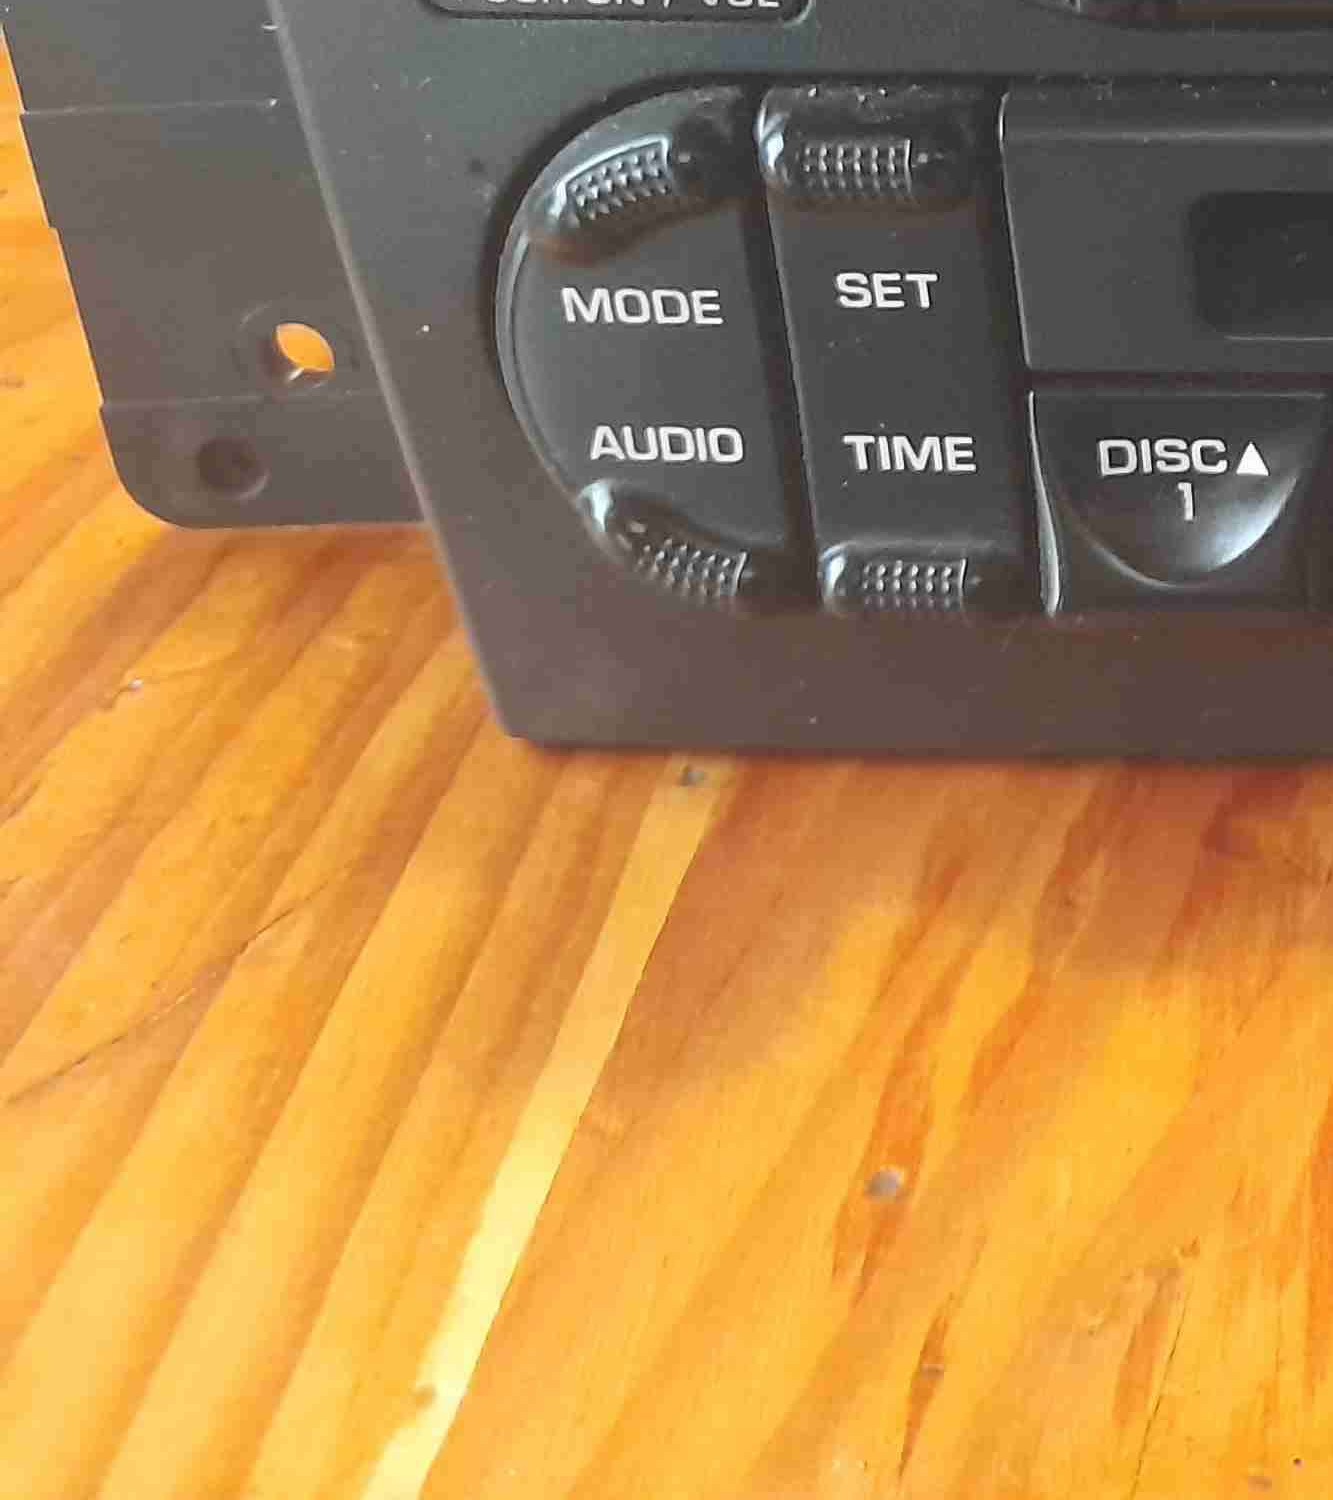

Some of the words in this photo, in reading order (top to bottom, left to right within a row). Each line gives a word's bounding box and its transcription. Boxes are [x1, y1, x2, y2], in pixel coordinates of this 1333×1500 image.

[560, 286, 725, 327] MODE
[834, 272, 938, 310] SET
[589, 425, 745, 464] AUDIO
[842, 434, 977, 473] TIME
[1098, 438, 1229, 478] DISC
[1177, 482, 1195, 522] 1
